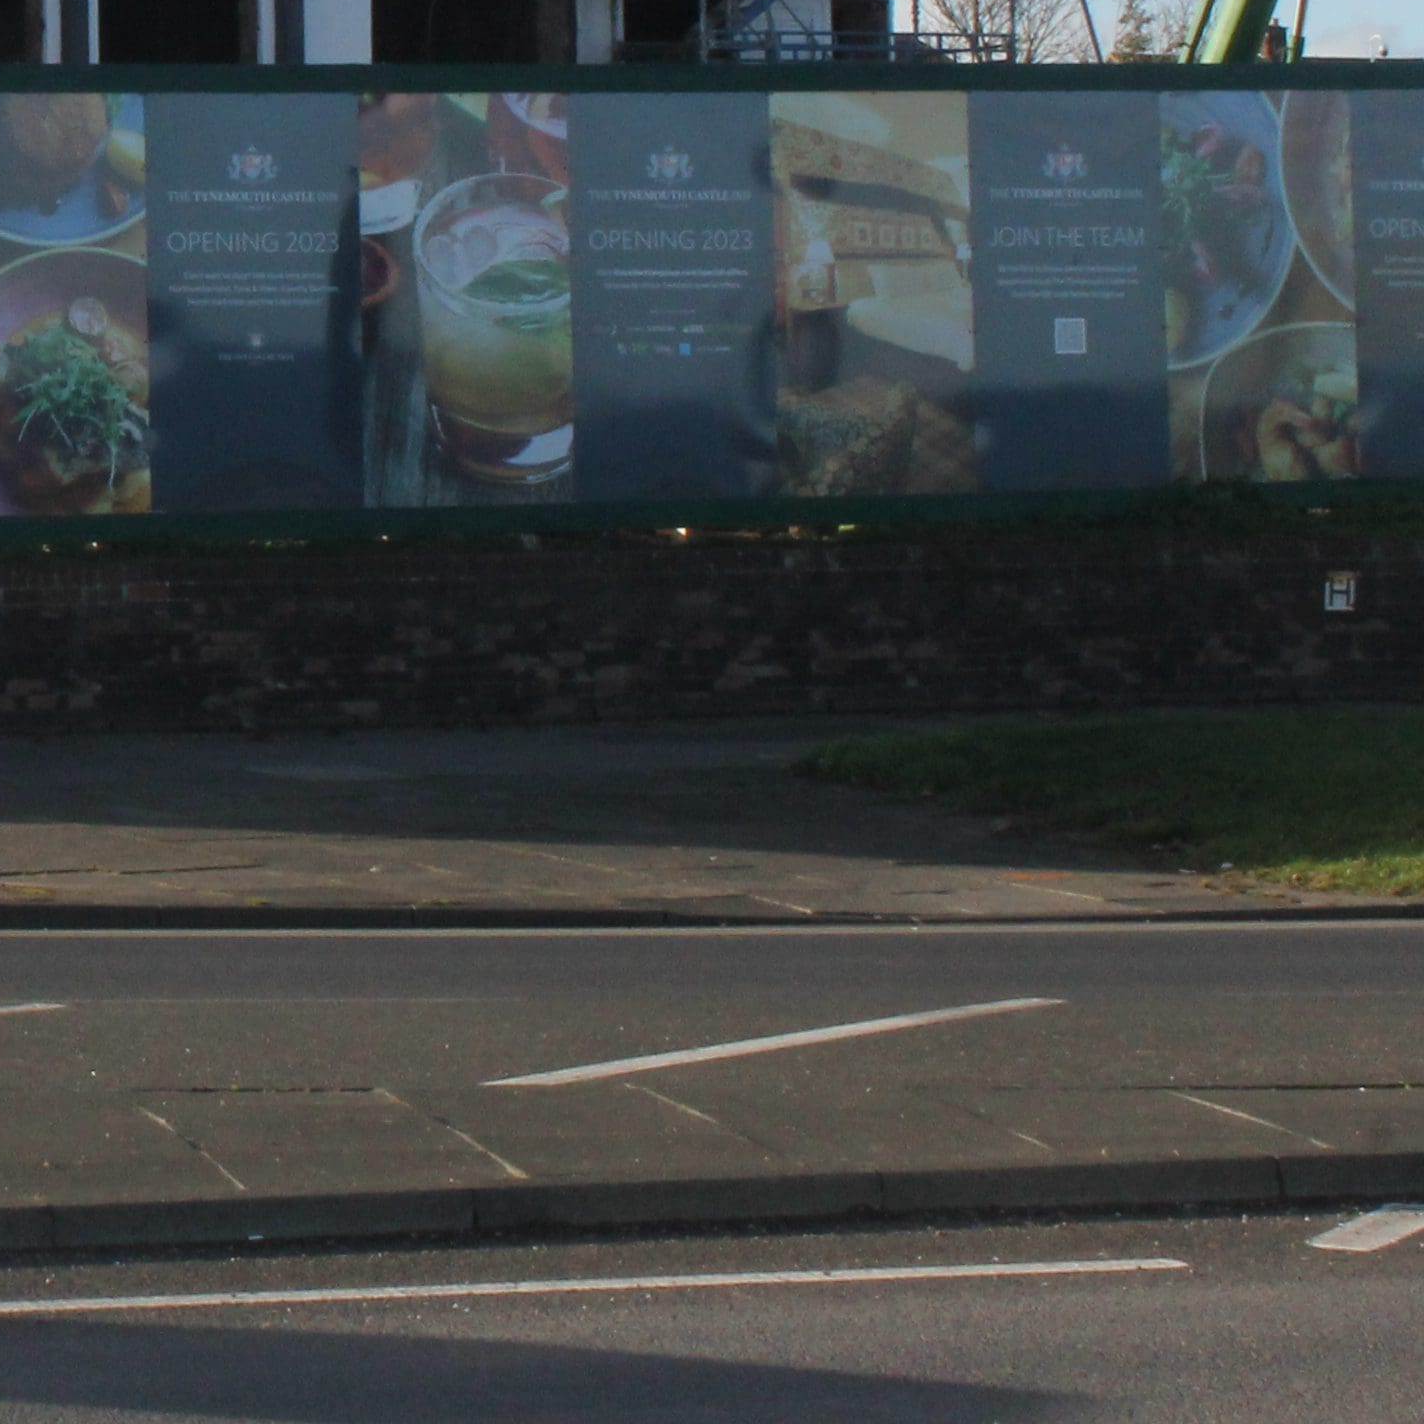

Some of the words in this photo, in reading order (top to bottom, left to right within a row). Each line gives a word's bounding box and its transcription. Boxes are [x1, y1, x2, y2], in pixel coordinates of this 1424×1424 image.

[166, 230, 280, 254] OPENING
[286, 230, 340, 254] 2023
[587, 228, 696, 252] OPENING
[702, 228, 753, 252] 2023
[989, 226, 1041, 248] JOIN
[1046, 226, 1085, 248] THE
[1089, 225, 1146, 248] TEAM
[1329, 581, 1350, 607] H
